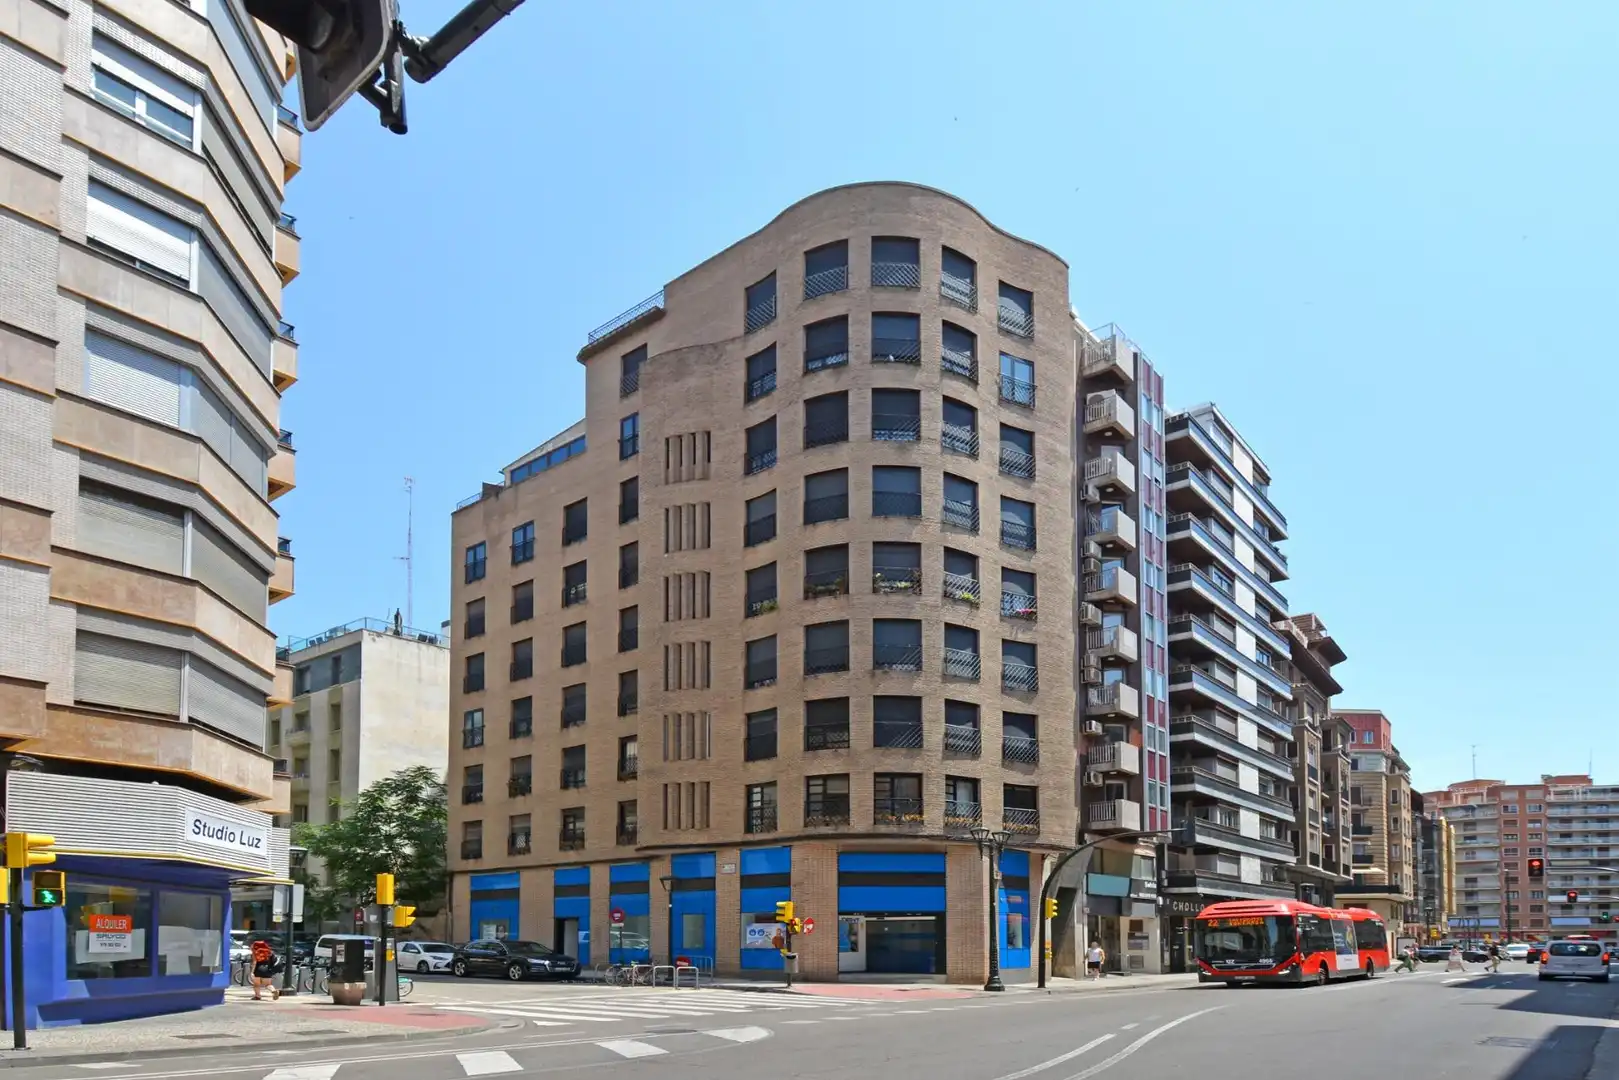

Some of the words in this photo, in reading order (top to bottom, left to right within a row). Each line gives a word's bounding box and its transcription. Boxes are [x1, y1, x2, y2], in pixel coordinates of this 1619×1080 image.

[192, 818, 236, 843] Studio
[239, 830, 262, 849] Luz
[96, 918, 127, 930] ALQUILER
[1207, 918, 1219, 927] 22
